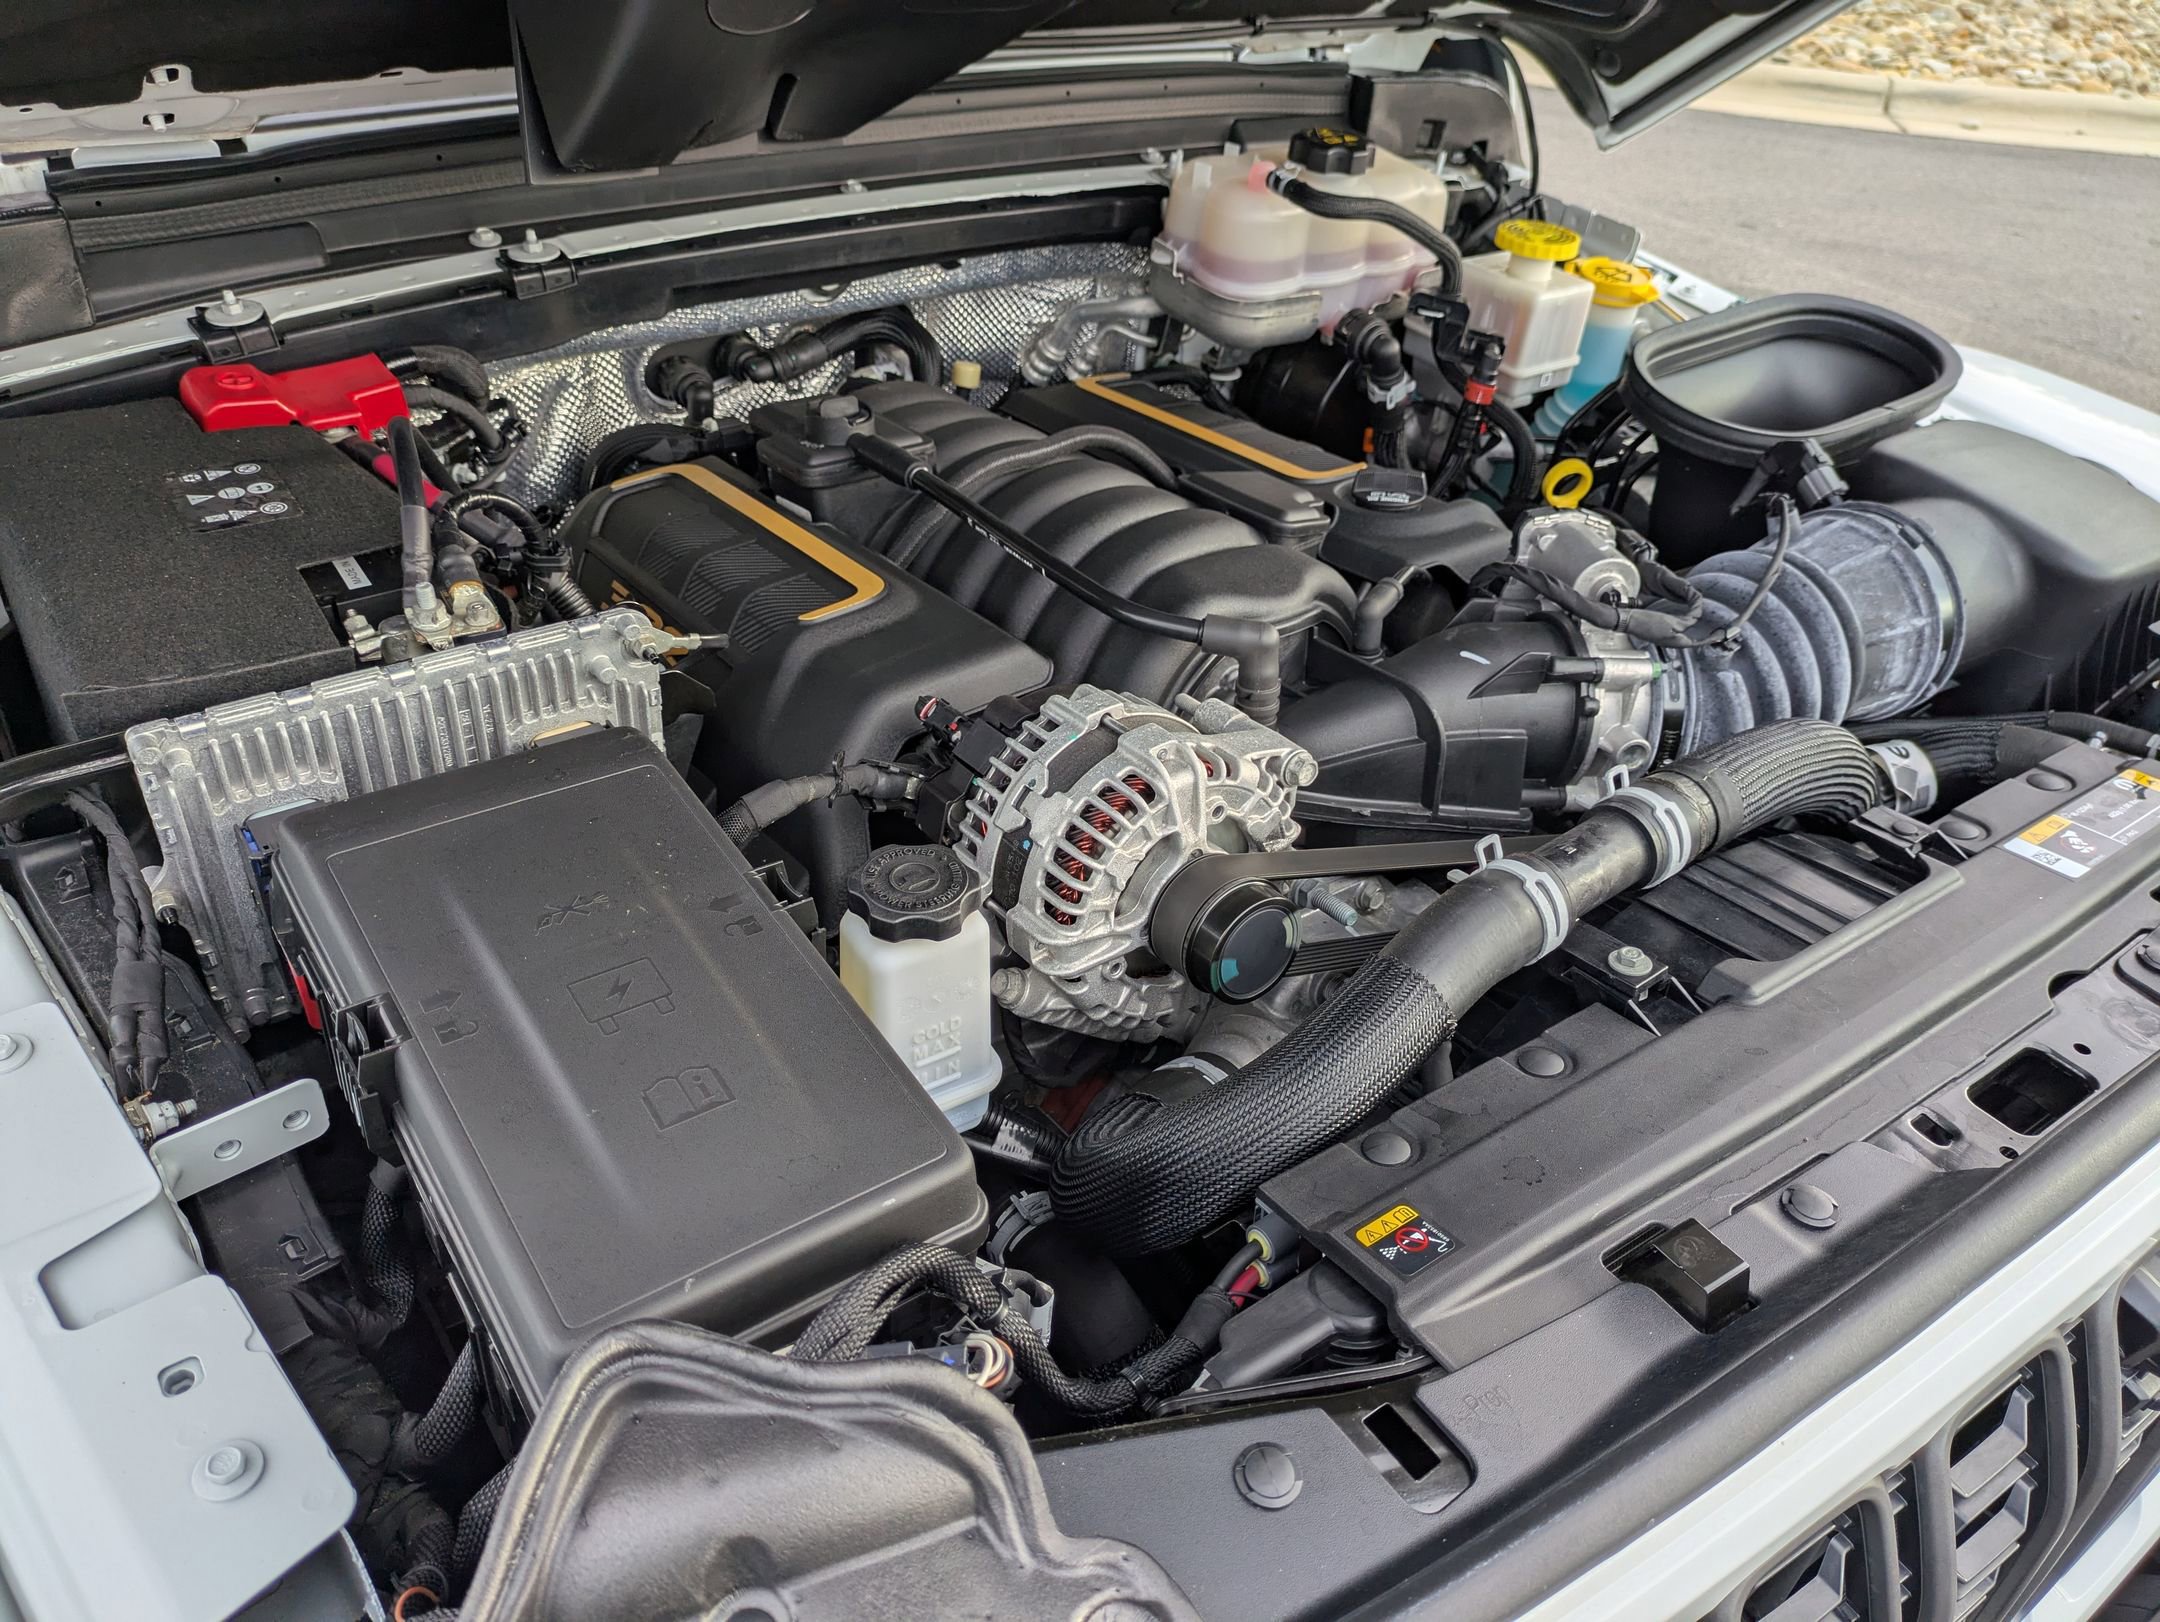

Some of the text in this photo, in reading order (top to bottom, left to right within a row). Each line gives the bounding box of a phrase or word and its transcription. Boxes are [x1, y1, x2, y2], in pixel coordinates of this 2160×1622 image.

[344, 567, 362, 585] MADE
[879, 847, 937, 867] APPROVED
[873, 889, 912, 909] POWER
[915, 882, 961, 910] STEERING
[912, 1015, 962, 1044] COLD
[912, 1031, 962, 1061] MAX
